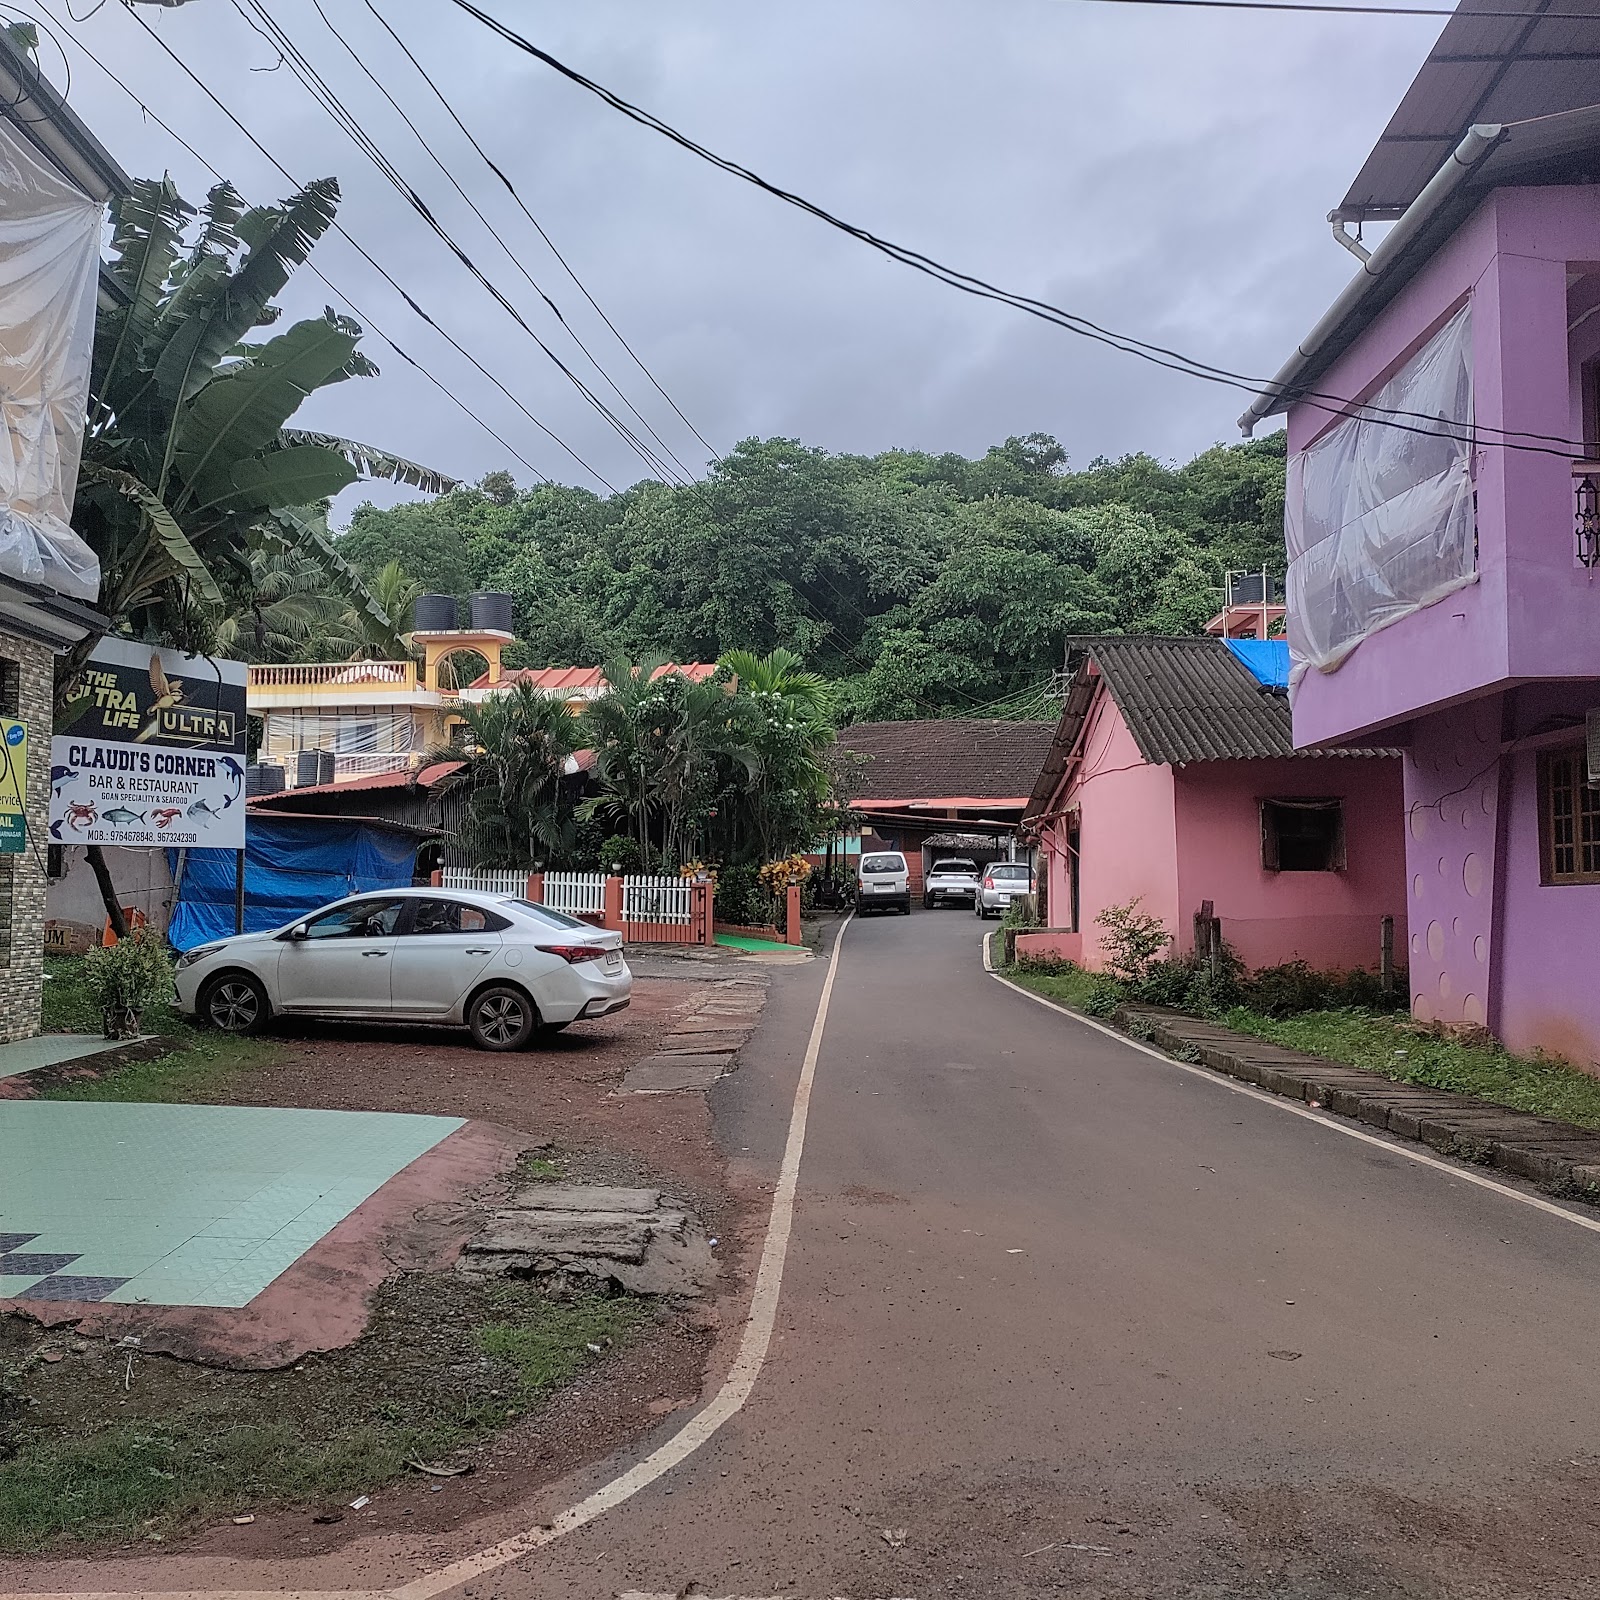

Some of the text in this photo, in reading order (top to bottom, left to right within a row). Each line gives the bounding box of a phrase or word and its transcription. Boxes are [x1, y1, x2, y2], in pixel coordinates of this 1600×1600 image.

[86, 670, 117, 688] THE
[102, 711, 141, 729] LIFE
[163, 711, 230, 737] ULTRA
[69, 745, 216, 778] CLAUDI'S CORNER
[89, 774, 199, 795] BAR & RESTAURANT
[101, 791, 188, 805] GOAN SPECIALITY & SEAFOOD
[157, 832, 197, 843] 9673242390
